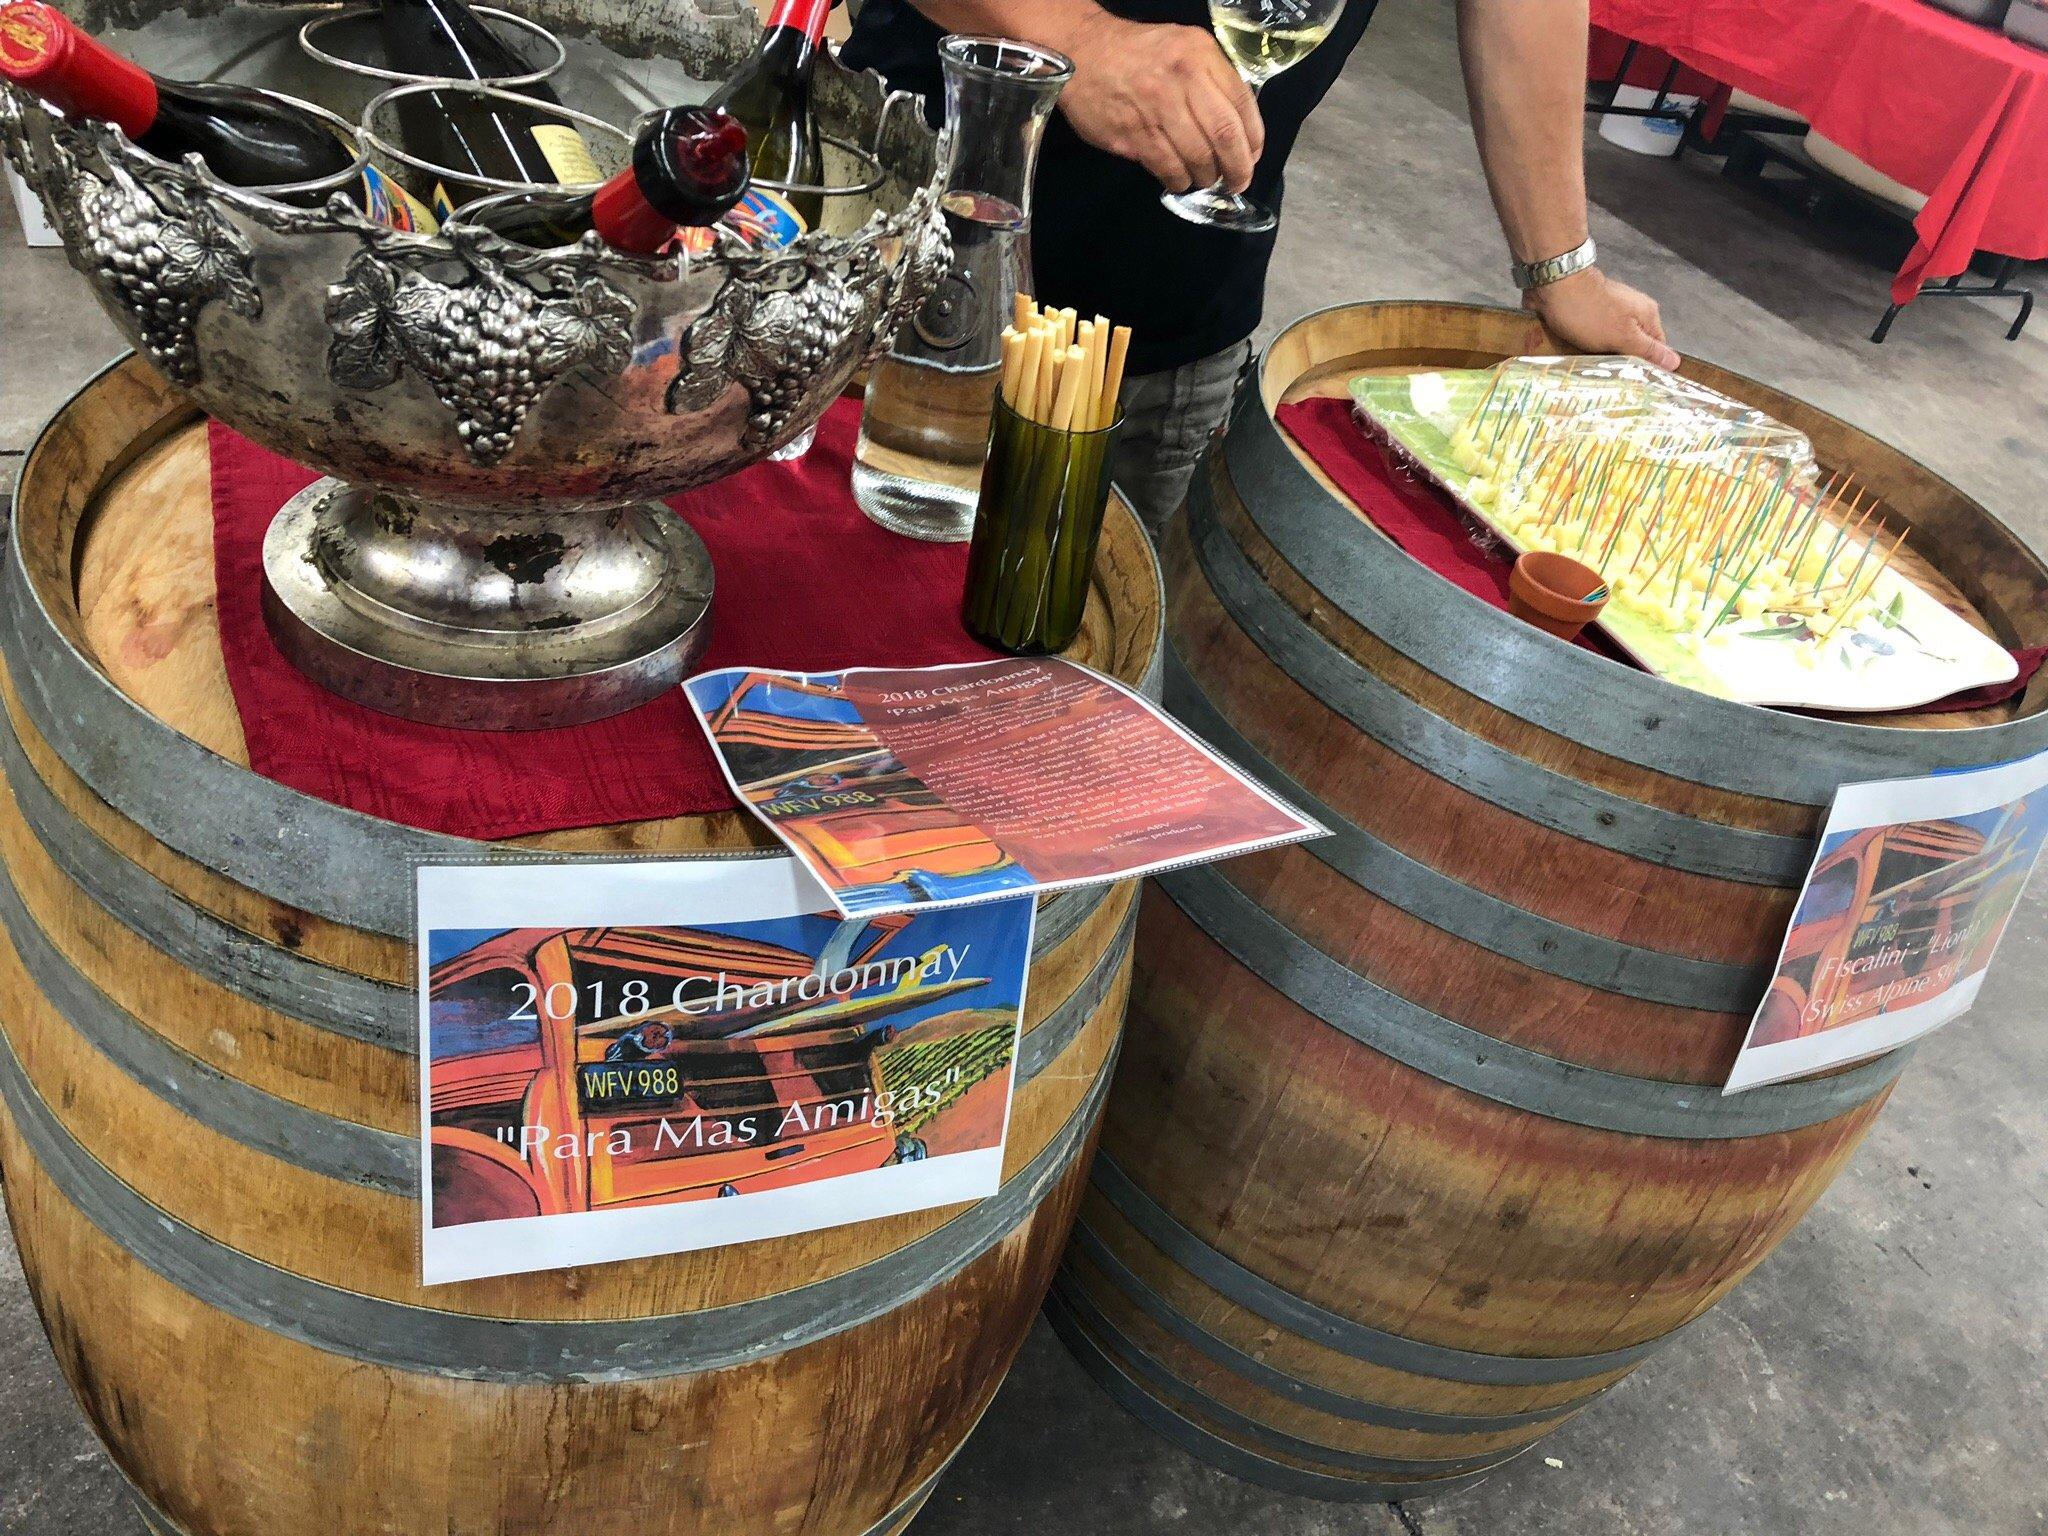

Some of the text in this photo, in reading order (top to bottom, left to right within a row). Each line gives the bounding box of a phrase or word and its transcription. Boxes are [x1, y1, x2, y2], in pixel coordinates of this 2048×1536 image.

[878, 665, 1041, 704] 2018 Chardonnay
[940, 692, 980, 706] Mas
[894, 741, 934, 754] produce
[936, 734, 964, 744] some
[995, 716, 1022, 725] finest
[911, 733, 934, 742] from
[936, 724, 968, 736] Collier
[914, 719, 962, 735] Livermore
[980, 731, 996, 740] our
[998, 713, 1057, 733] Chardonnay
[1000, 741, 1024, 750] wine
[1027, 733, 1046, 742] that
[1058, 724, 1074, 732] the
[1076, 715, 1101, 726] color
[922, 776, 946, 785] pear
[949, 761, 1014, 777] intermingled
[1015, 754, 1038, 762] with
[1040, 744, 1074, 755] vanilla
[1076, 737, 1094, 745] oak
[1096, 729, 1114, 738] and
[925, 765, 959, 776] yellow
[1061, 727, 1095, 741] aromas
[948, 785, 974, 793] scent
[1046, 759, 1076, 769] butter
[1078, 749, 1117, 761] coming
[1118, 741, 1141, 750] from
[1001, 762, 1034, 773] deeper
[1038, 754, 1066, 764] smell
[1068, 744, 1102, 755] reveals
[1010, 778, 1036, 787] early
[1040, 770, 1070, 779] stages
[1084, 756, 1118, 768] cookie
[1070, 771, 1096, 780] there
[760, 791, 876, 816] WFV 988
[960, 805, 992, 815] aroma
[1008, 795, 1034, 804] early
[1038, 784, 1083, 796] morning
[983, 808, 1014, 817] pretty
[1067, 788, 1094, 798] burst
[1096, 782, 1108, 790] in
[1110, 777, 1132, 788] your
[1136, 768, 1170, 779] mouth
[1022, 818, 1042, 826] has
[1043, 811, 1076, 821] bright
[1080, 801, 1114, 813] acidity
[1118, 793, 1138, 803] and
[1170, 776, 1210, 789] without
[1028, 805, 1062, 817] french
[1064, 800, 1084, 808] oak
[1086, 791, 1116, 802] flavor
[1120, 782, 1153, 793] arrives
[1182, 765, 1204, 775] The
[1058, 819, 1082, 828] silky
[1086, 808, 1121, 820] texture
[1160, 789, 1196, 801] tongue
[1032, 832, 1054, 840] way
[1112, 810, 1150, 823] toasted
[1152, 805, 1172, 813] oak
[1118, 823, 1204, 847] cases produced
[1146, 822, 1169, 831] ABV
[1853, 925, 1880, 948] WFV
[1819, 942, 1911, 980] Fiscalini
[507, 944, 970, 1021] 2018 Chardonnay
[1800, 993, 1862, 1026] (Swiss
[1869, 976, 1930, 1010] Alpine
[584, 1068, 679, 1100] WFV 988
[497, 1066, 960, 1162] "Para Mas Amigas"
